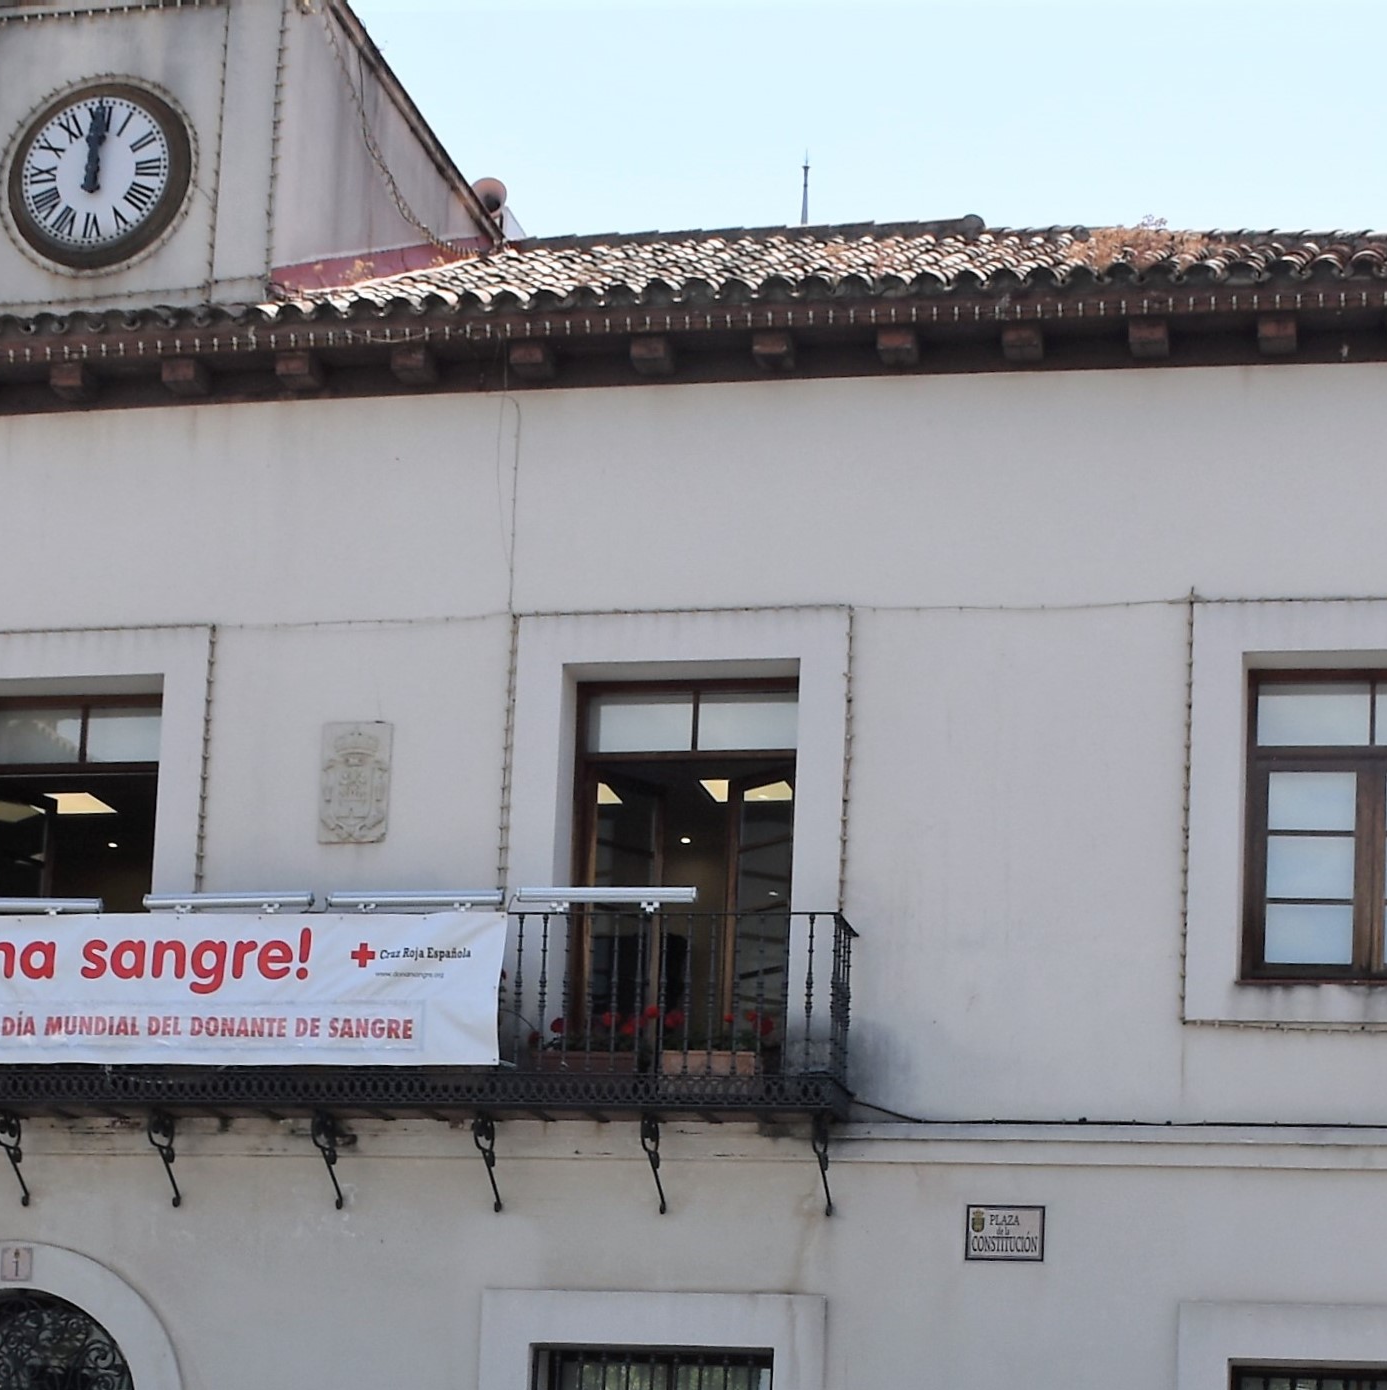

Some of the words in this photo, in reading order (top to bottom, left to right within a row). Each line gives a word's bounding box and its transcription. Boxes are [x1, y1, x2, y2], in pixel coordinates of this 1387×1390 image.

[80, 927, 312, 994] sangre!
[379, 949, 401, 960] Cruz
[402, 947, 425, 961] Roja
[427, 947, 472, 962] Española
[1, 1010, 37, 1037] DÍA
[43, 1015, 141, 1037] MUNDIAL
[147, 1016, 182, 1037] DEL
[189, 1016, 288, 1038] DONANTE
[294, 1017, 321, 1038] DE
[328, 1018, 414, 1040] SANGRE
[990, 1214, 1020, 1226] PLAZA
[972, 1230, 1039, 1253] CONSTITUCIÓN
